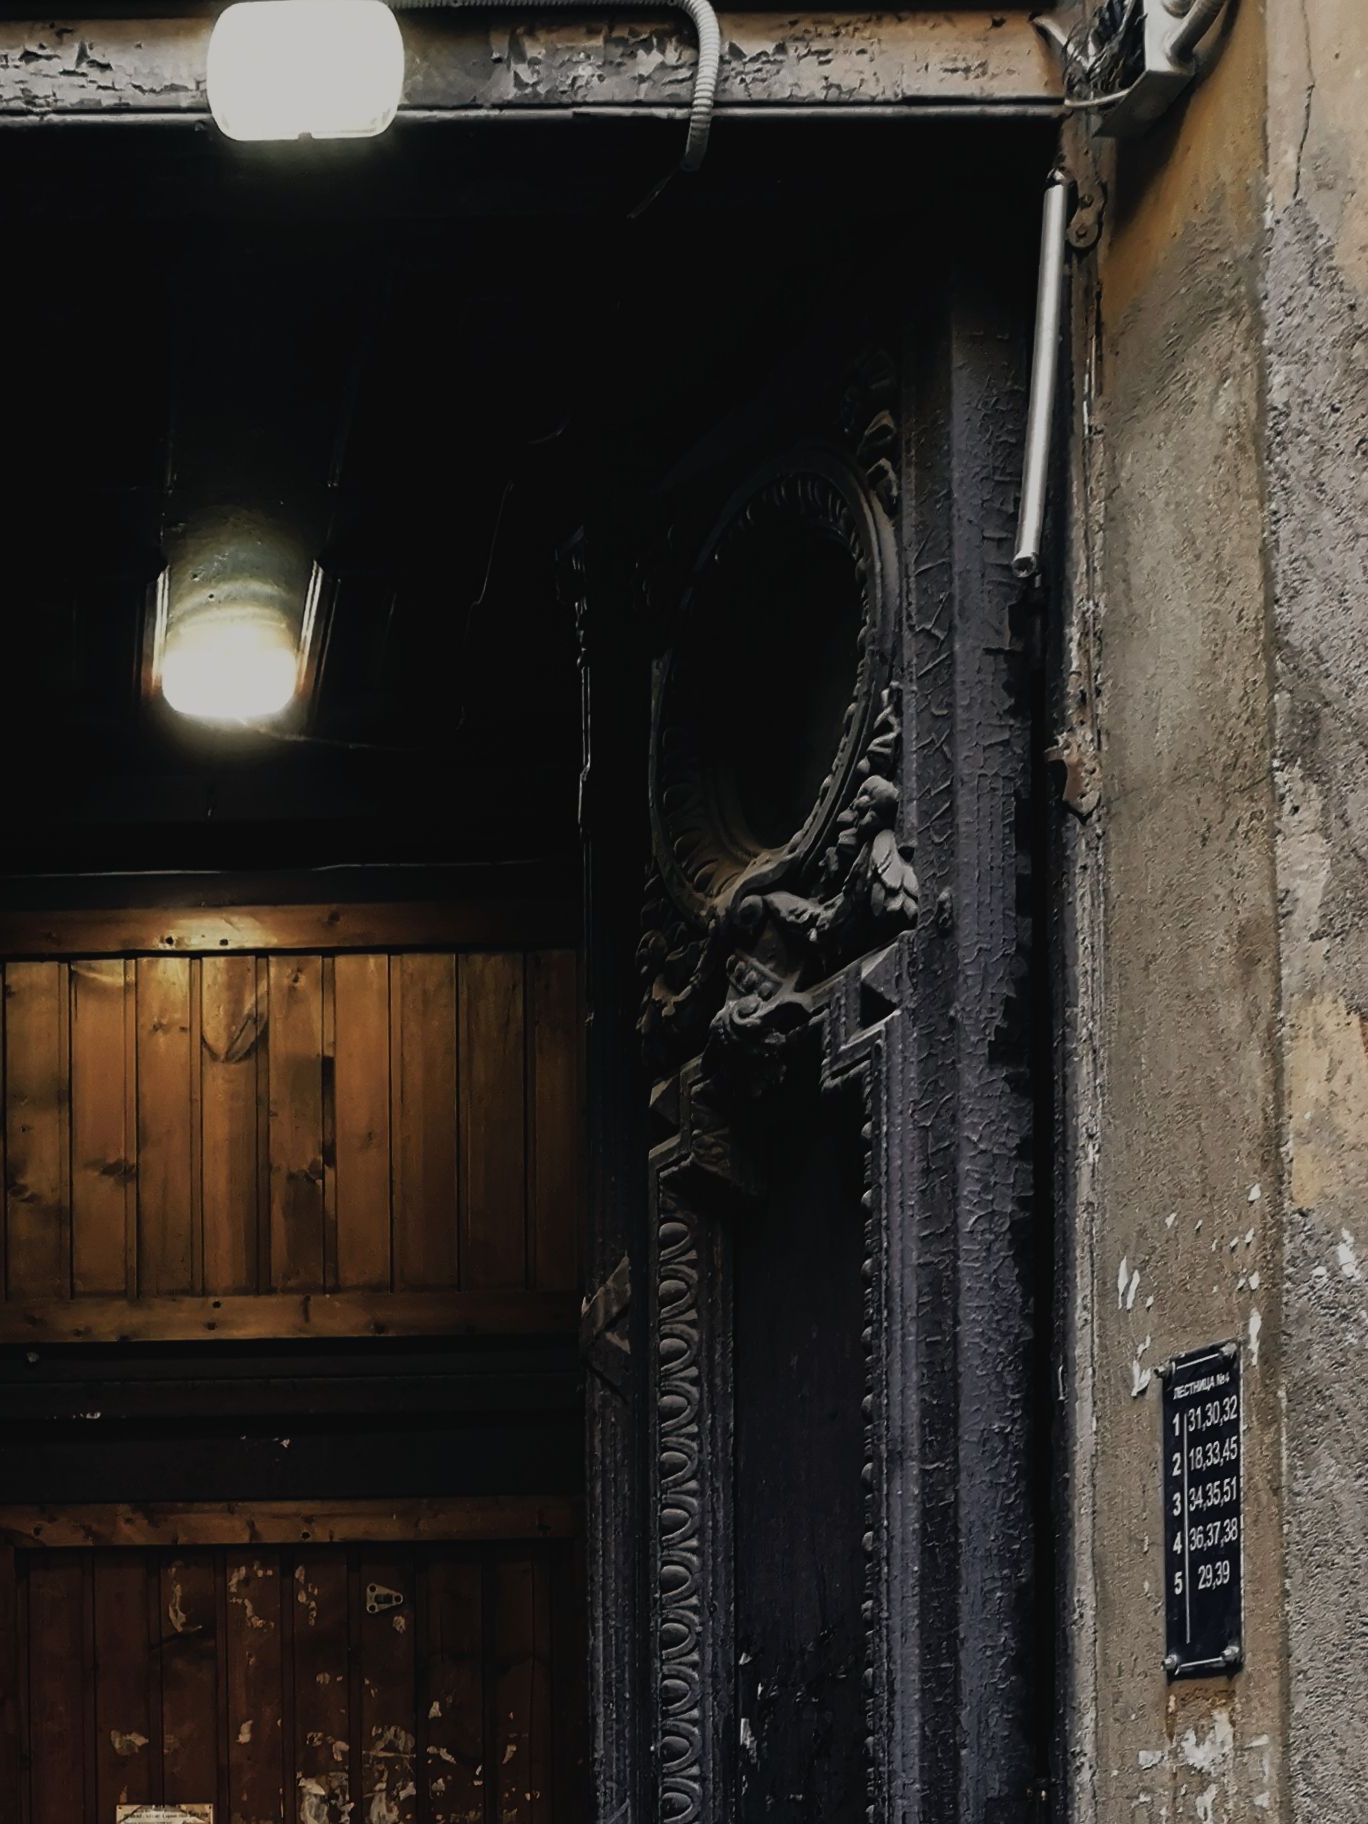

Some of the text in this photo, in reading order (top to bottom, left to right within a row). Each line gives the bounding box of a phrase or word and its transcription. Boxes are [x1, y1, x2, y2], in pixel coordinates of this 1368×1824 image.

[1173, 1376, 1214, 1400] ЛЕСТНИЦА
[1172, 1395, 1238, 1437] 1 31,30,32
[1172, 1435, 1238, 1477] 2 18,33,45
[1172, 1476, 1237, 1516] 3 34,35,51
[1173, 1518, 1238, 1554] 4 36,37,38
[1174, 1560, 1230, 1595] 5 29,39
